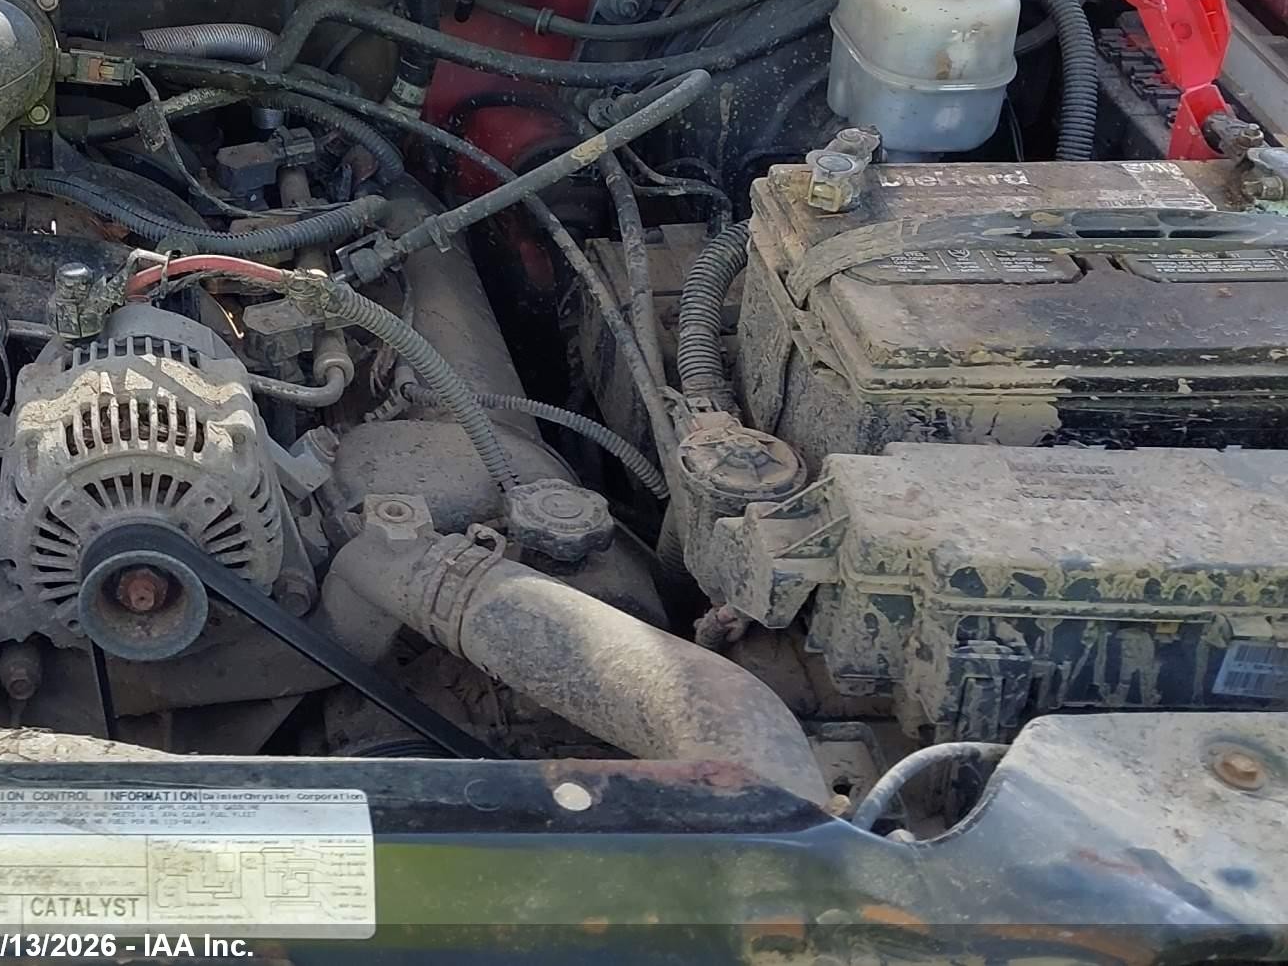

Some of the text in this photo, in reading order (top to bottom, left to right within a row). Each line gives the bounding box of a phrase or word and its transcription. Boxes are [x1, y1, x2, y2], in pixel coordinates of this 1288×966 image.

[31, 791, 93, 802] CONTROL
[103, 790, 199, 802] INFORMATION
[202, 792, 363, 804] DaimlerChrysler Corporation
[30, 896, 140, 917] CATALYST
